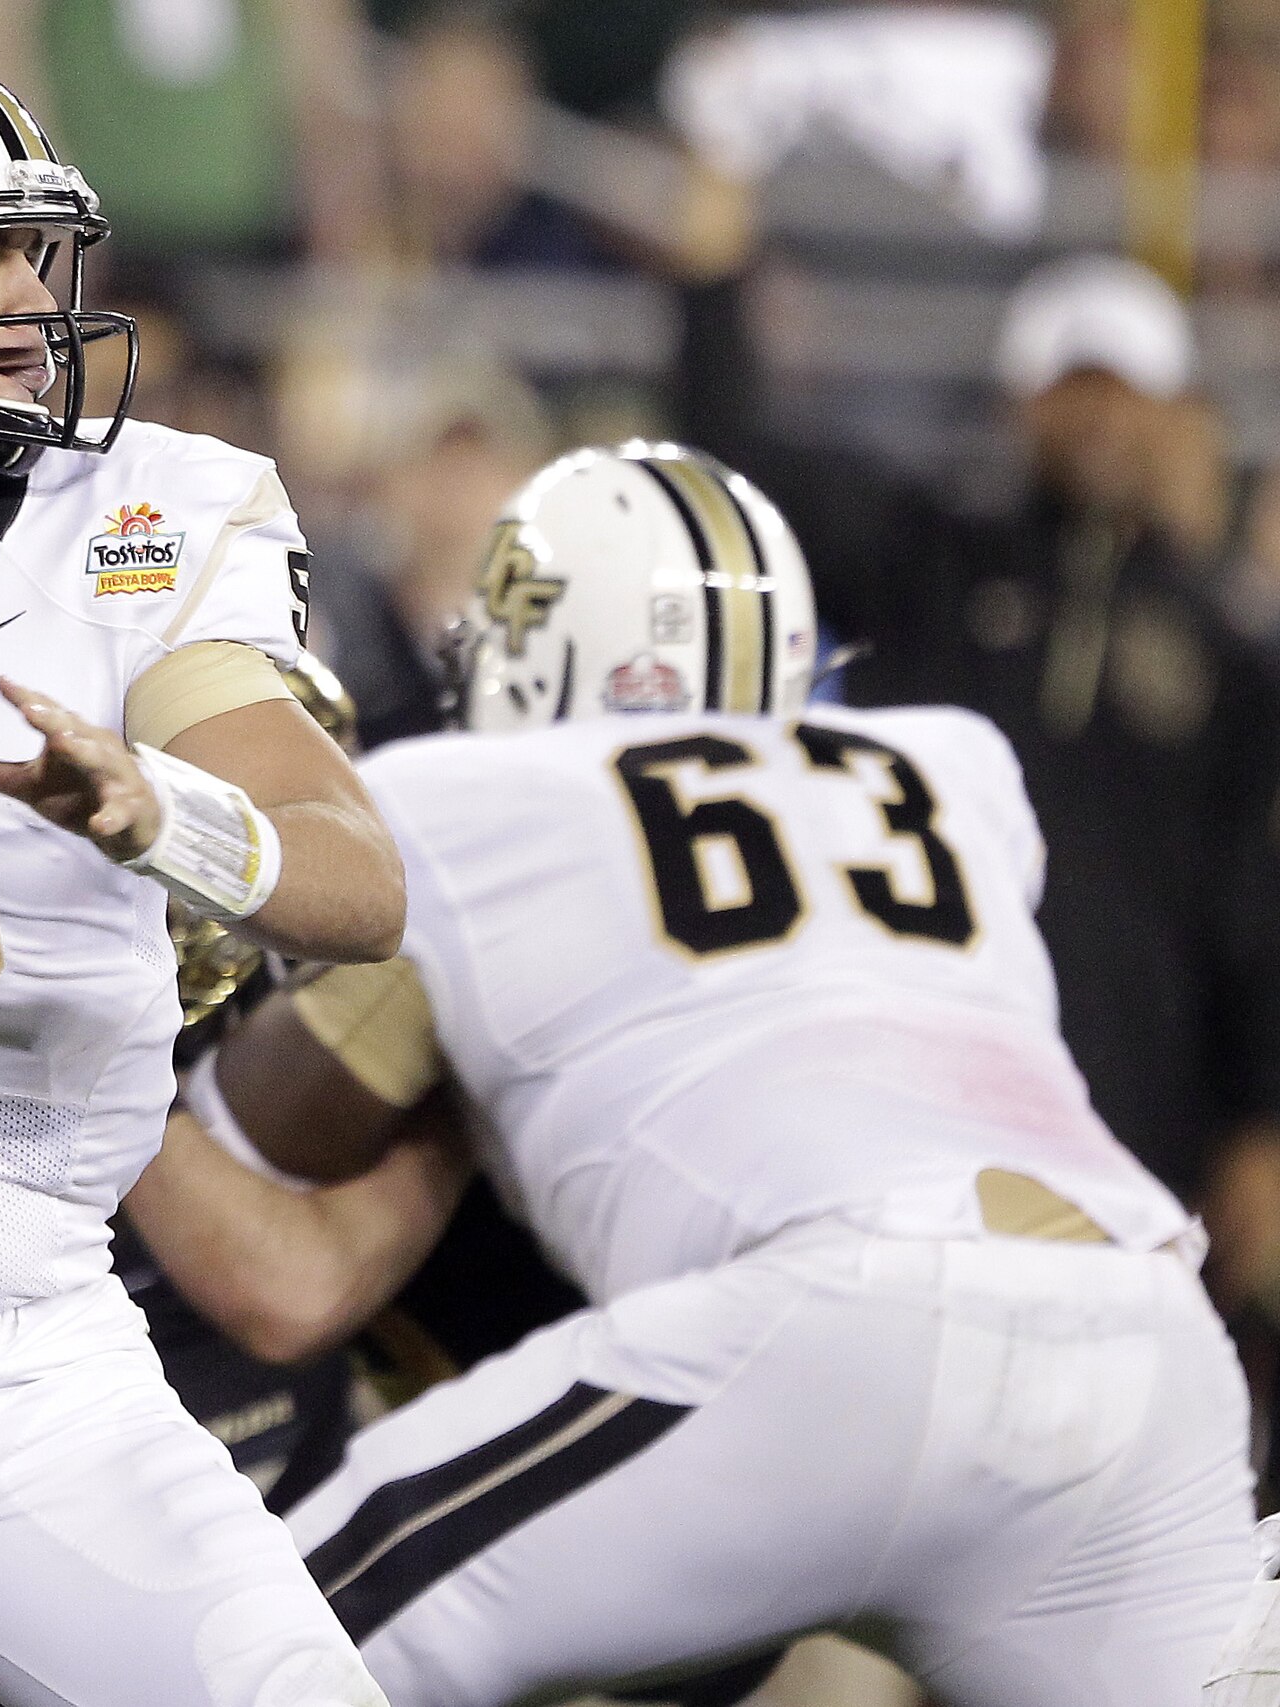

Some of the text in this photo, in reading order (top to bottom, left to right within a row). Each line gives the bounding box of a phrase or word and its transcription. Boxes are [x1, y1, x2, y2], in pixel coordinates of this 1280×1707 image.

[100, 573, 175, 589] FIESTA BOWL
[610, 720, 981, 966] 63
